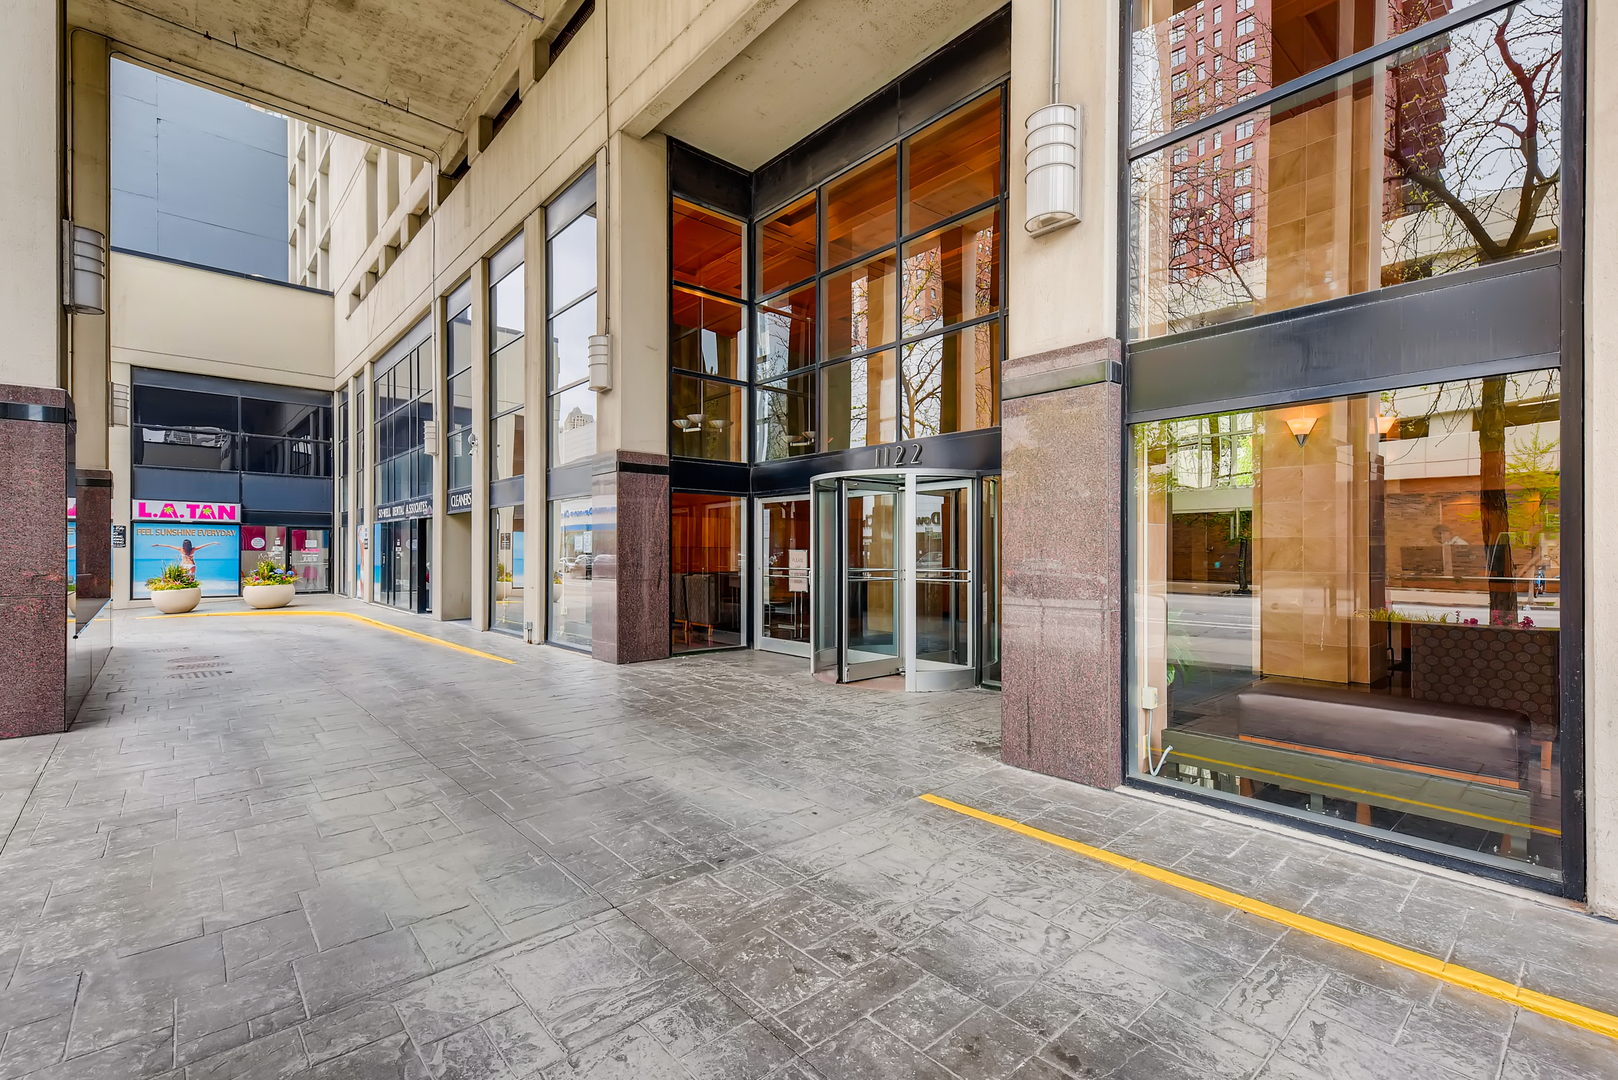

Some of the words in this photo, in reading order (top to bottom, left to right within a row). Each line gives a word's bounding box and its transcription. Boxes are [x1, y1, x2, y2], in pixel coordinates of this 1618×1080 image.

[874, 443, 922, 467] 1122
[450, 492, 472, 507] CLEANERS
[392, 504, 405, 517] DENTAL
[405, 501, 428, 515] ASSOCIATES
[136, 528, 154, 536] FEEL
[155, 528, 196, 537] SUNSHINE
[197, 529, 237, 537] EVERYDAY
